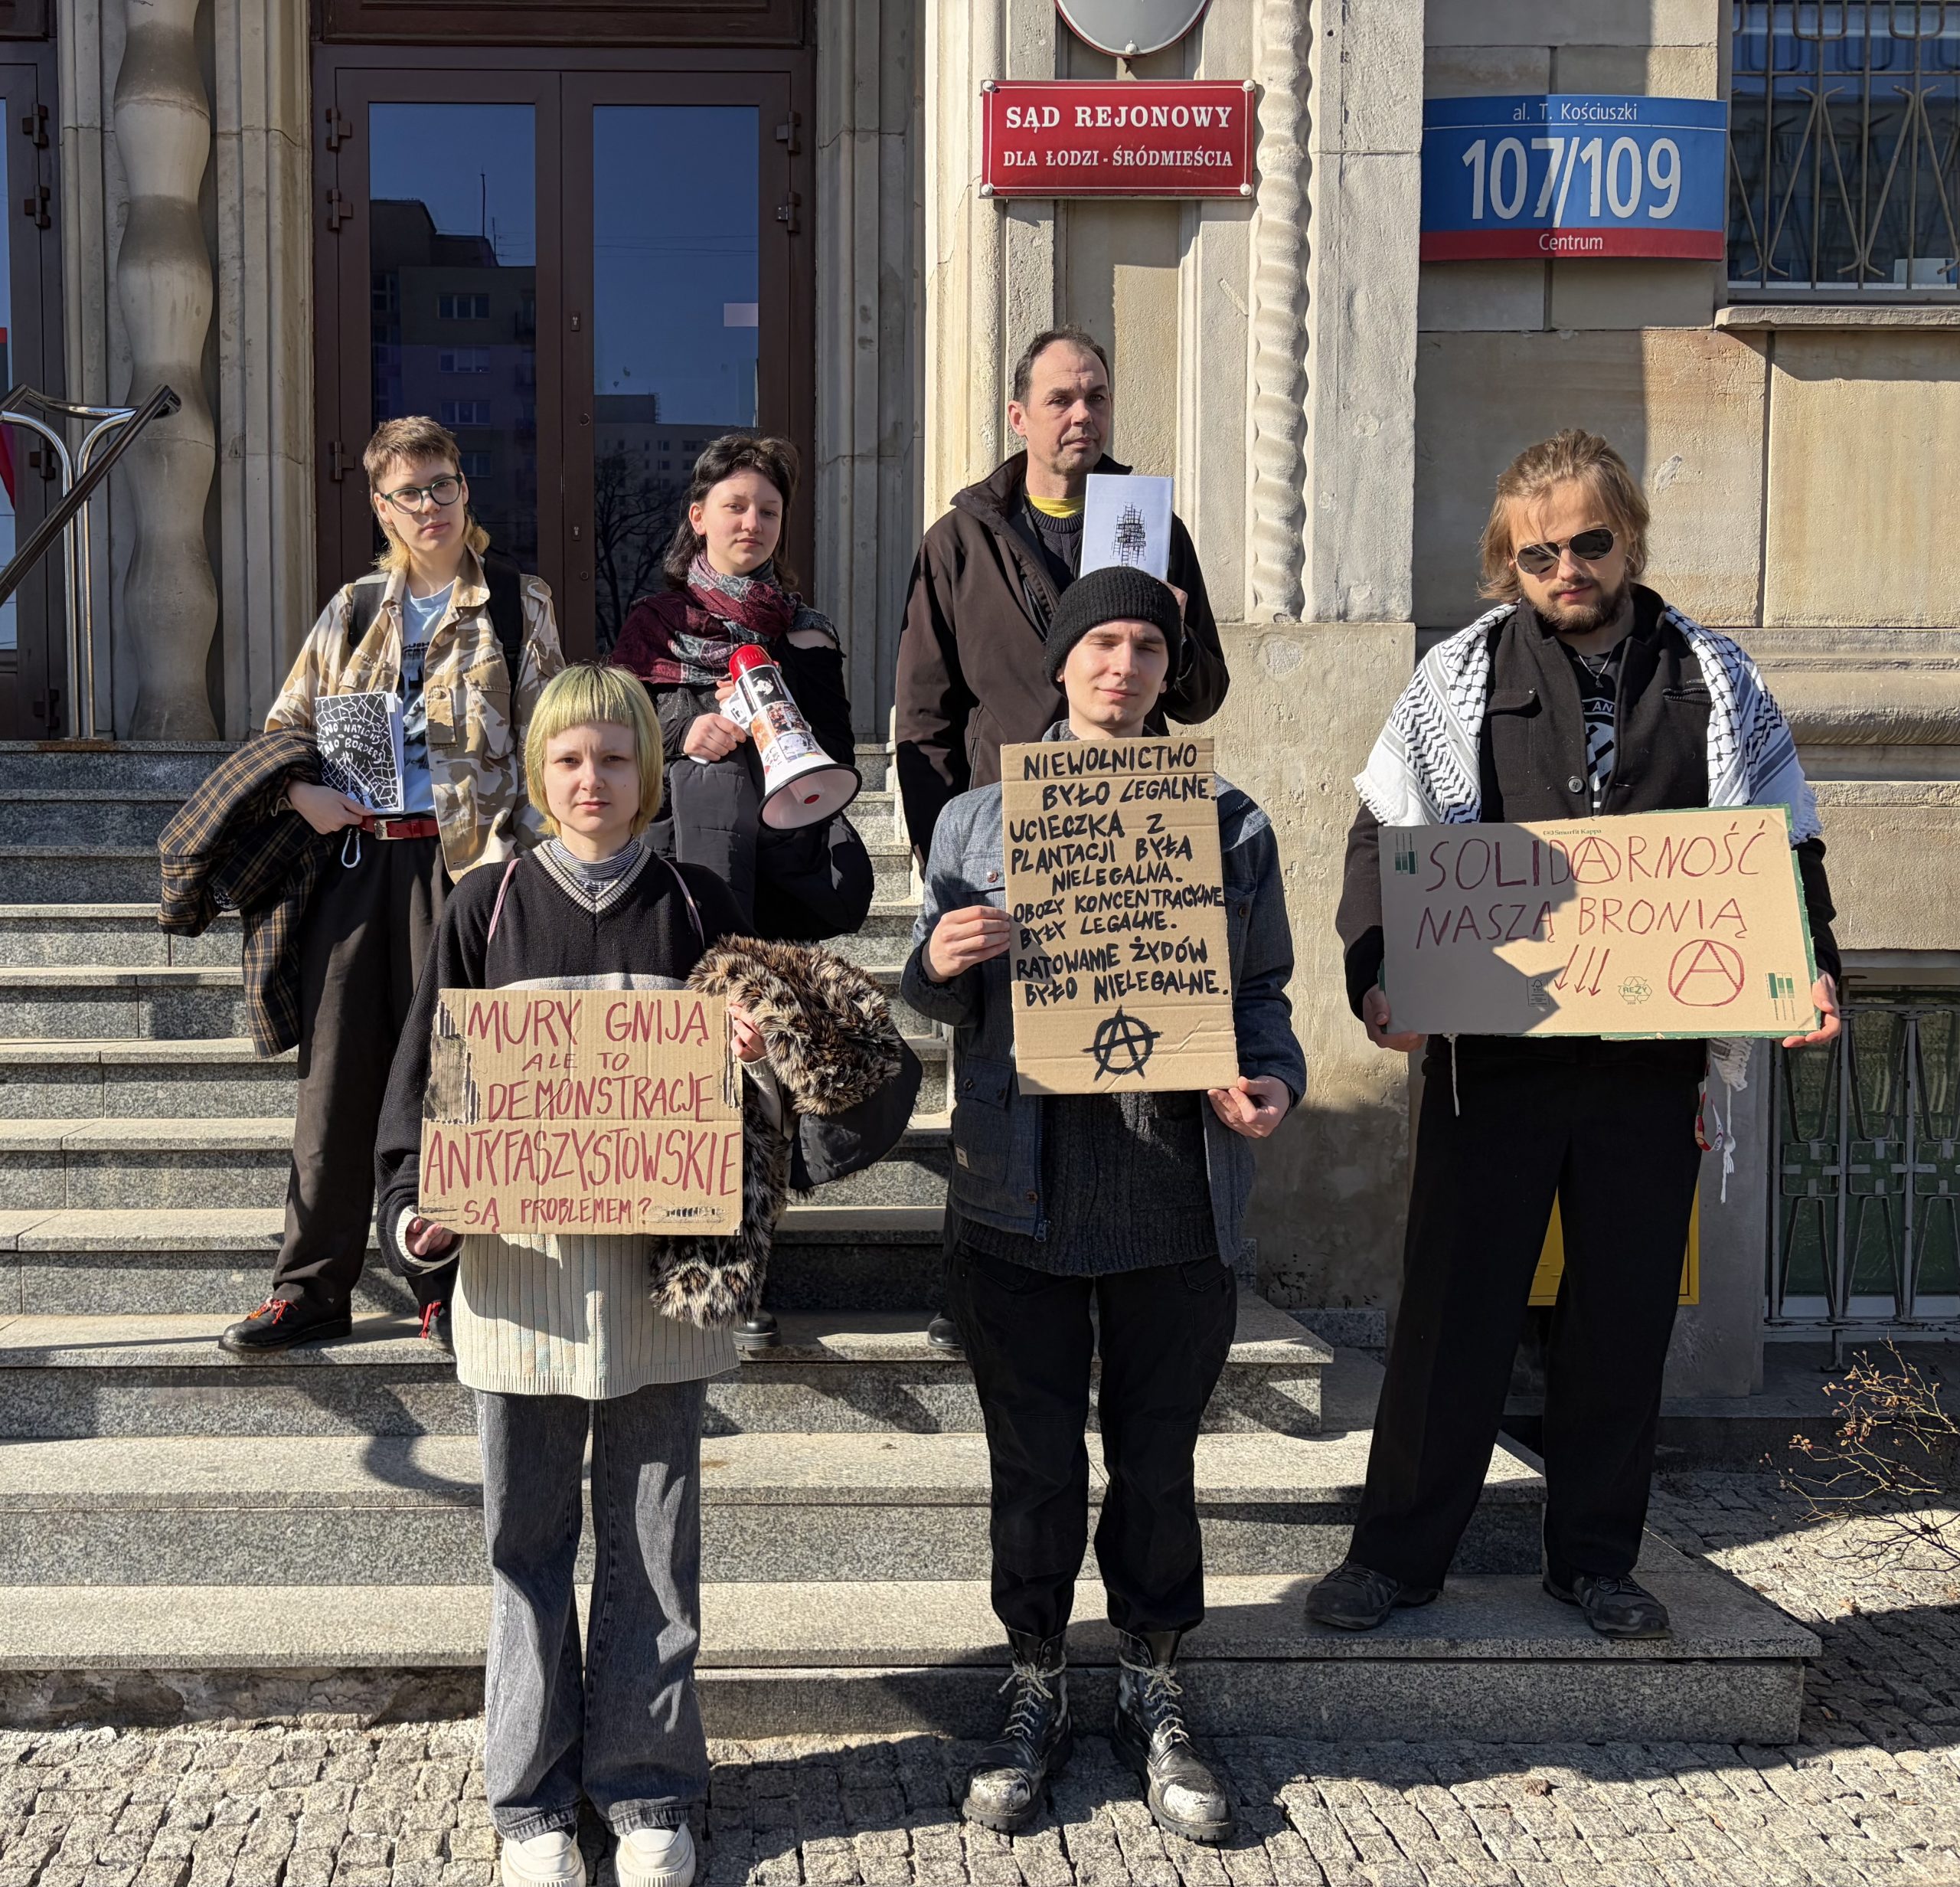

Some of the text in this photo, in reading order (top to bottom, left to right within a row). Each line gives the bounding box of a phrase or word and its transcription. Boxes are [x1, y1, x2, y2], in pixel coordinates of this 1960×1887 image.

[1005, 106, 1233, 134] SĄD REJONOWY
[1513, 102, 1637, 120] al. T. Kościuszki
[1003, 151, 1037, 167] DLA
[1046, 150, 1099, 167] ŁODZI
[1112, 144, 1233, 167] ŚRÓDMIEŚCIA
[1462, 136, 1681, 228] 107/109
[1539, 233, 1603, 250] Centrum
[324, 722, 381, 744] NO NATIONS
[324, 739, 340, 754] NO
[345, 737, 383, 764] BORDERS
[1023, 742, 1197, 781] NIEWOLNICTWO
[1042, 773, 1217, 811] BYŁO LEGALNE.
[1009, 809, 1166, 843] UCIECZKA Z
[1011, 833, 1193, 875] PLANTACJI BYŁA
[1426, 819, 1766, 892] SOLIDARNOŚĆ
[1052, 861, 1184, 896] NIELEGALNA.
[1013, 898, 1066, 924] OBOZY
[1020, 910, 1178, 950] BYŁY LEGALNE.
[1416, 897, 1748, 950] NASZĄ BRONIĄ
[1016, 935, 1208, 982] RATOWANIE ŻYDÓW
[1024, 969, 1229, 1007] BYŁO NIELEGALNE.
[467, 999, 710, 1053] MURY GNIJĄ
[521, 1051, 630, 1072] ALE TO
[488, 1071, 714, 1123] DEMONSTRACJE
[423, 1127, 741, 1196] ANTYFASZYSTOWSKIE
[464, 1197, 500, 1234] SĄ
